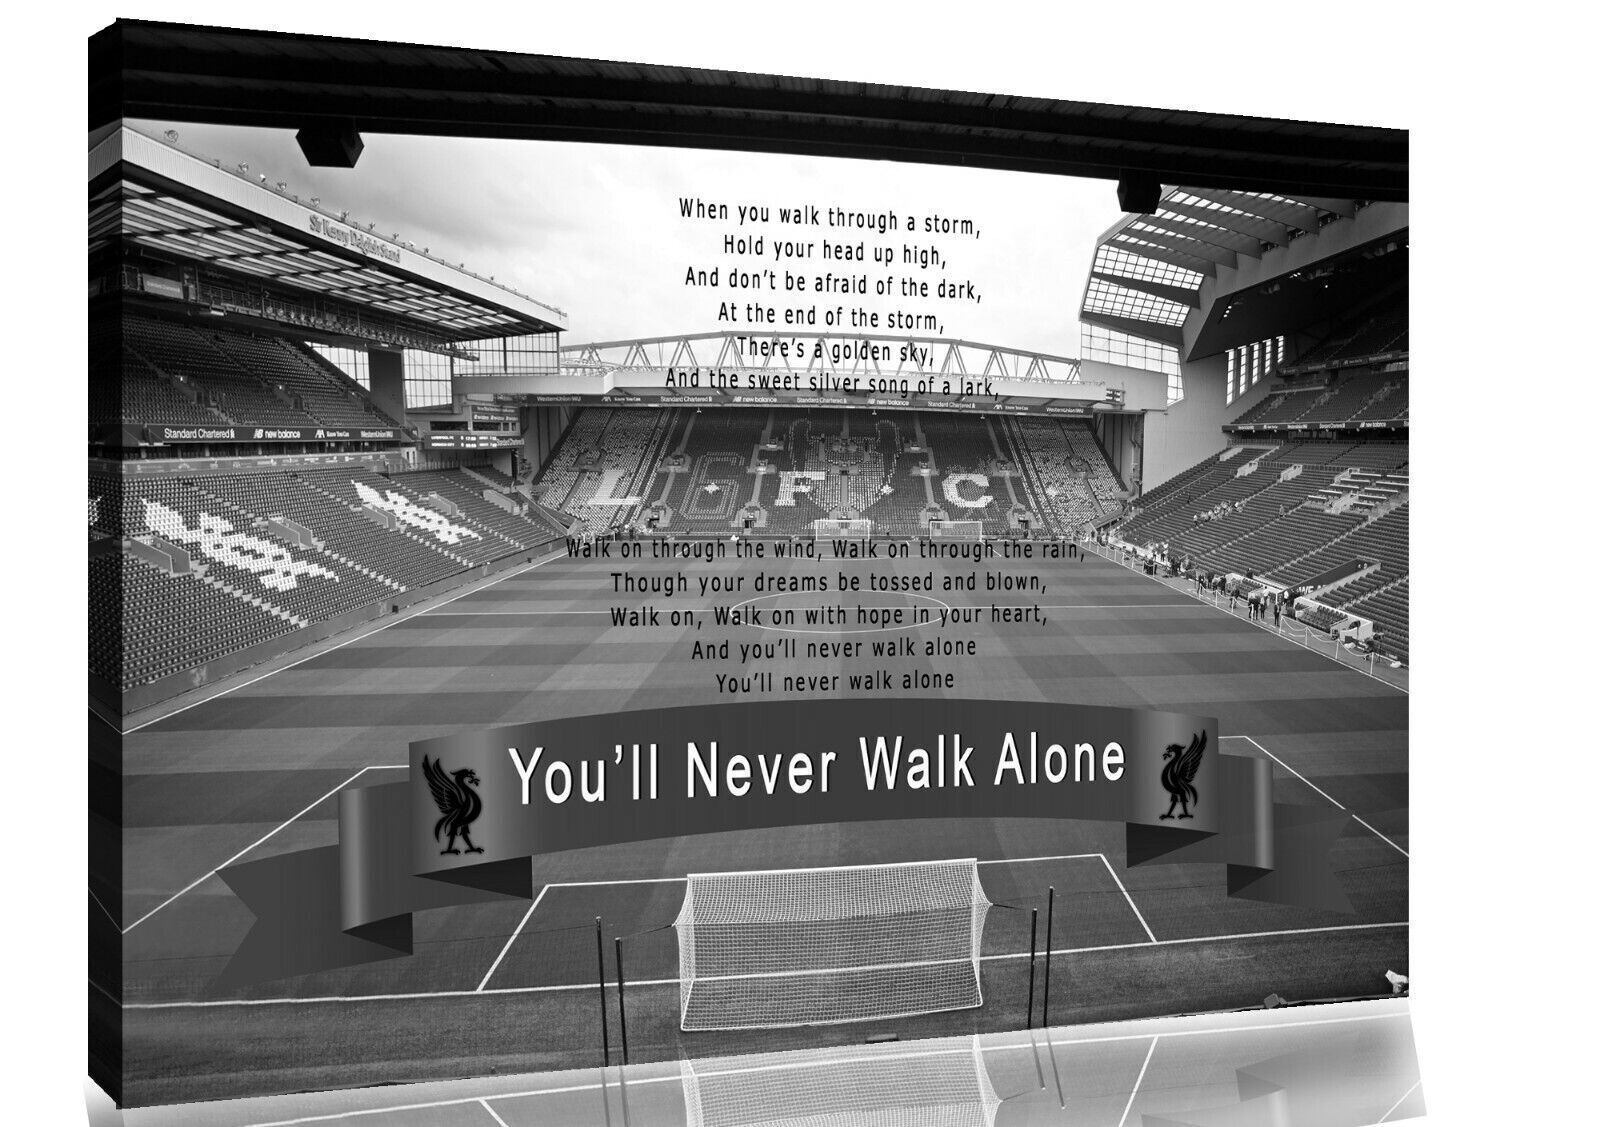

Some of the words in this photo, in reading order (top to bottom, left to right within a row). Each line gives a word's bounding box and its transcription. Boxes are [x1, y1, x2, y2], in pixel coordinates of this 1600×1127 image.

[164, 427, 197, 439] Standard
[197, 428, 230, 439] Chartered
[265, 430, 277, 439] new
[277, 429, 301, 439] balance
[943, 472, 993, 509] C
[508, 743, 659, 805] You’ll
[687, 741, 837, 798] Never
[859, 733, 976, 791] Walk
[993, 731, 1126, 786] Alone
